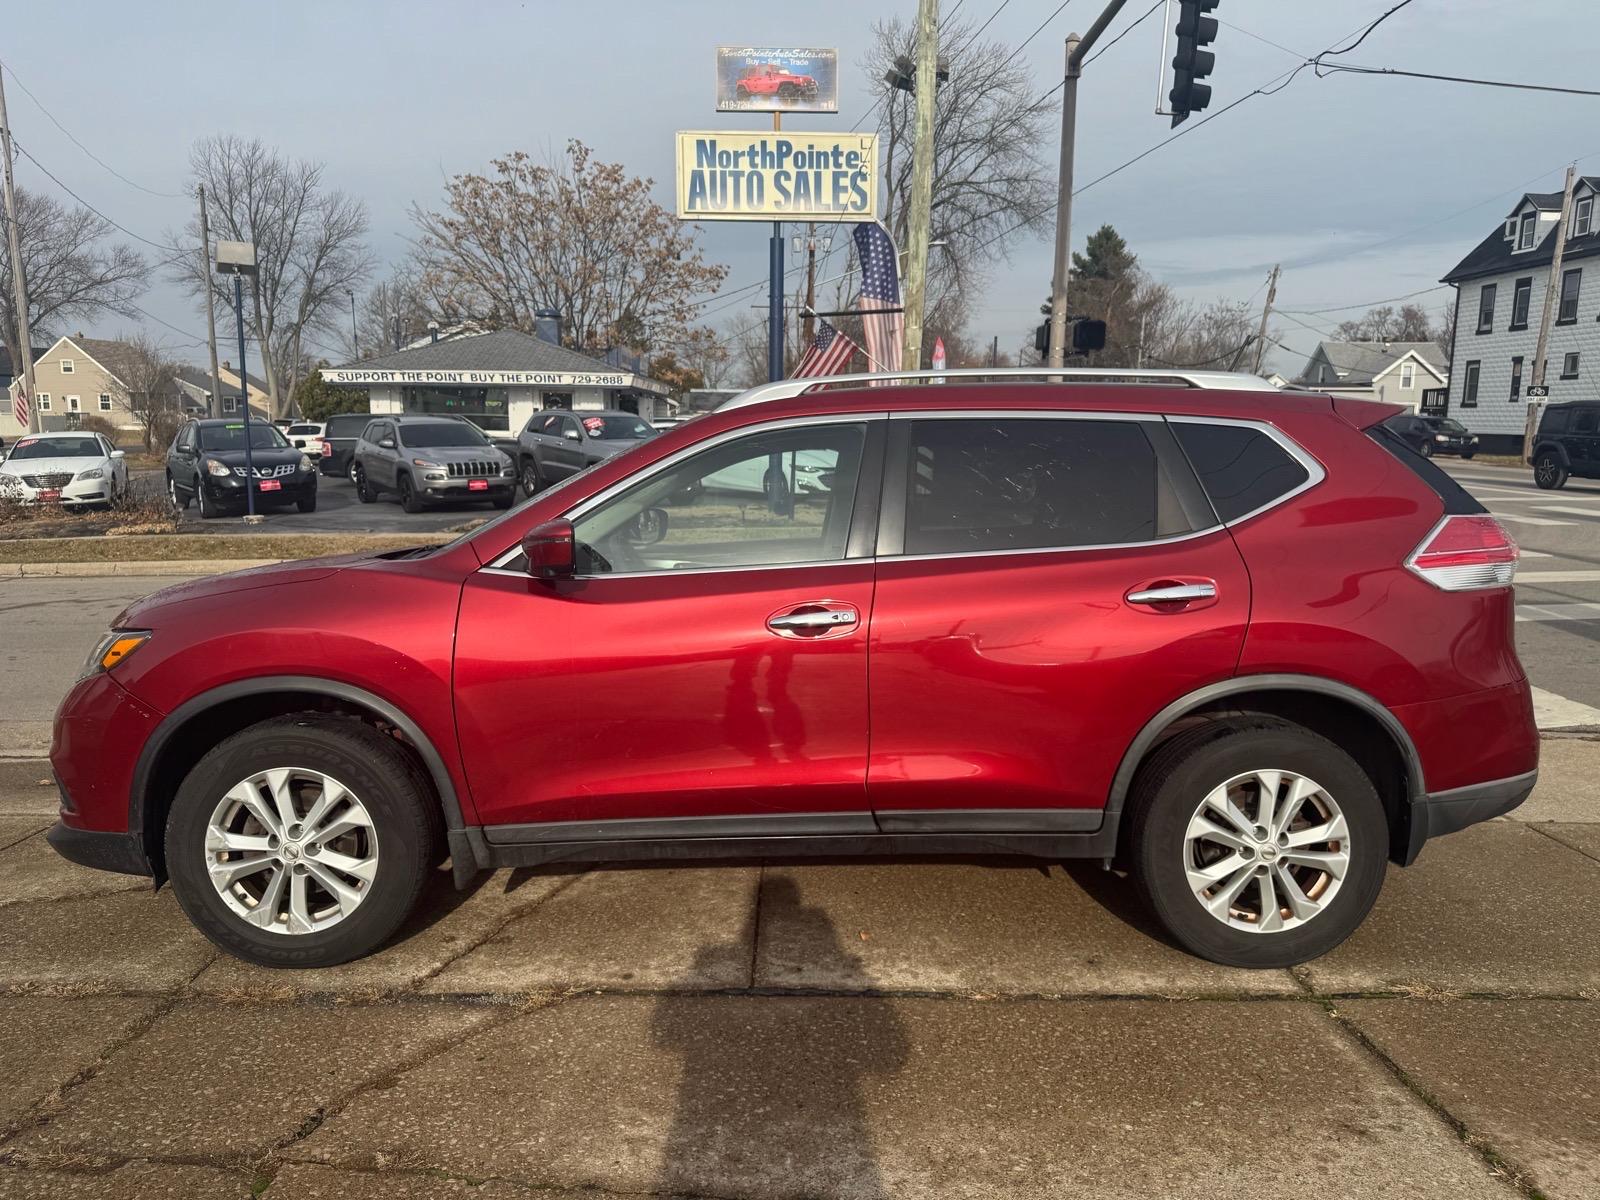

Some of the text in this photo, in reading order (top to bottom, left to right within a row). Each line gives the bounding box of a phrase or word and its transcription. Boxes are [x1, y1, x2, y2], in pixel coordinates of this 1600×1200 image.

[720, 48, 835, 58] NorthPointeAutoSales.com
[745, 58, 759, 66] Buy
[790, 58, 809, 66] Trade
[696, 139, 860, 170] NorthPointe
[688, 170, 868, 212] AUTO SALES
[337, 372, 624, 385] SUPPORT THE POINT BUY THE POINT 729-2688
